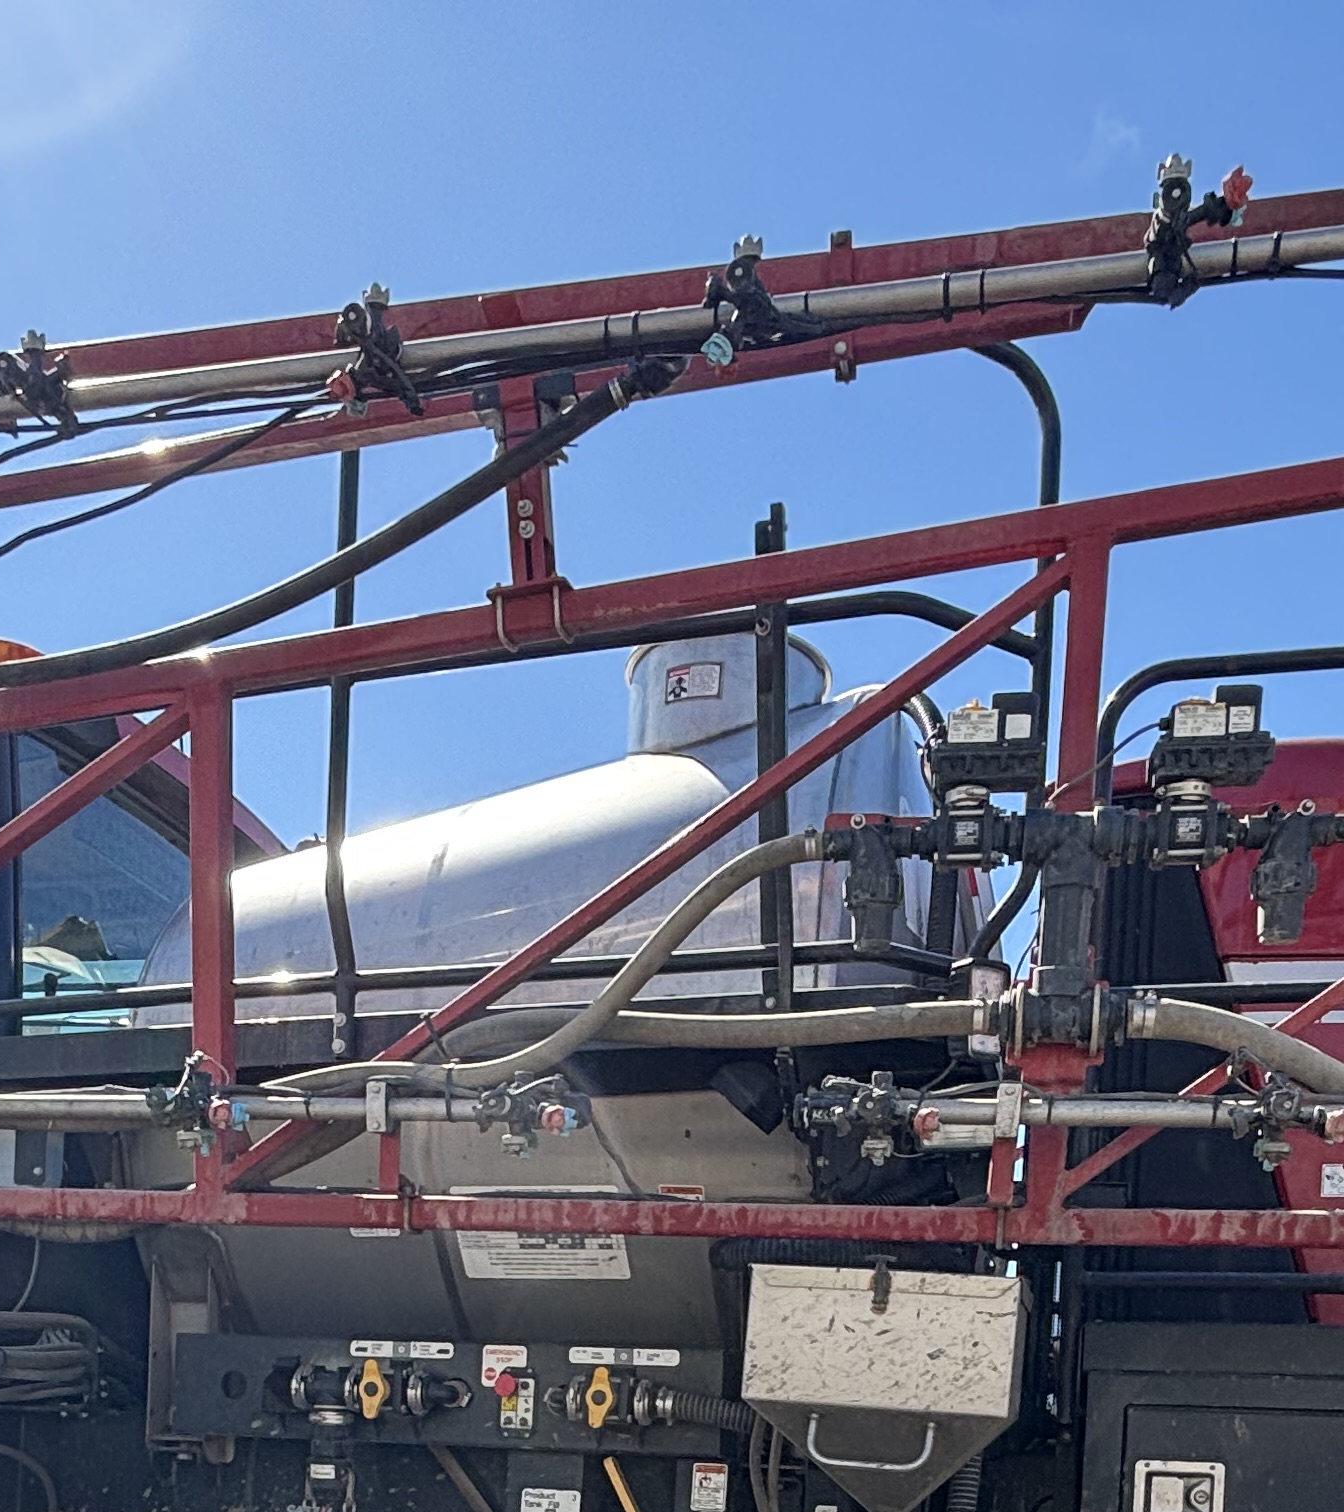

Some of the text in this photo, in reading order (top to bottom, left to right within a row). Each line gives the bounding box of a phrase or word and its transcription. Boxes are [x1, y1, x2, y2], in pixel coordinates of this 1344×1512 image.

[485, 1348, 525, 1357] EMERGENCY
[524, 1491, 556, 1500] Product
[524, 1500, 543, 1508] Tank
